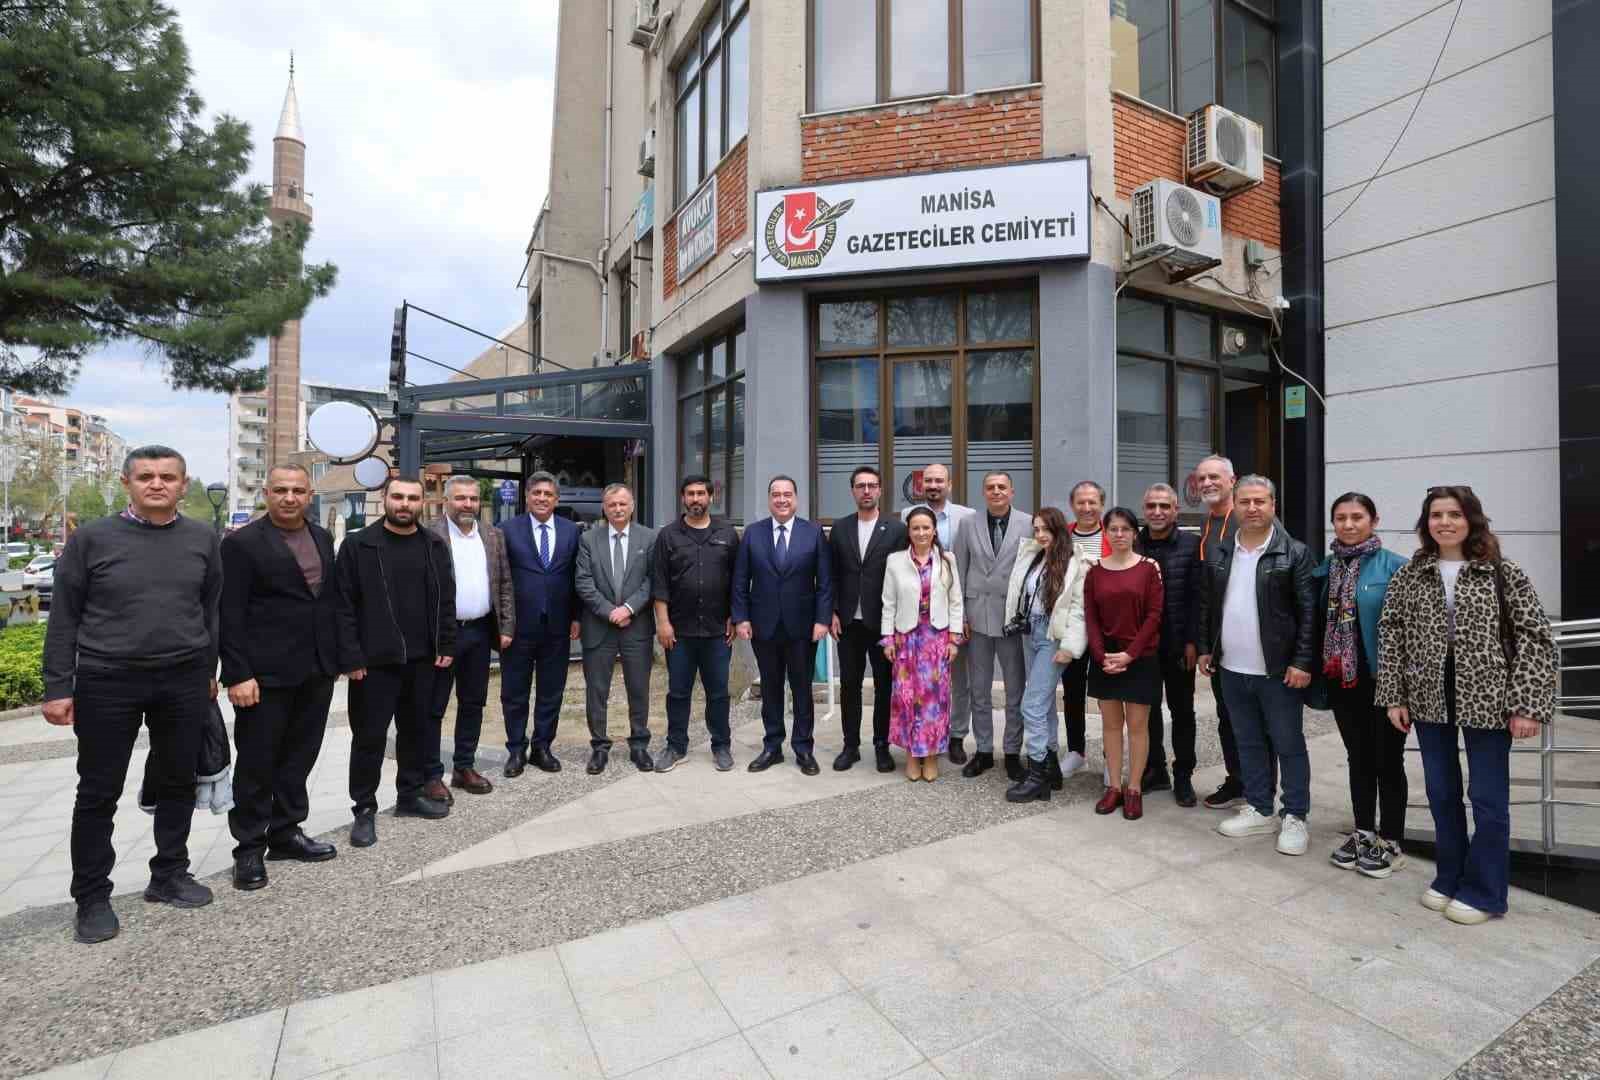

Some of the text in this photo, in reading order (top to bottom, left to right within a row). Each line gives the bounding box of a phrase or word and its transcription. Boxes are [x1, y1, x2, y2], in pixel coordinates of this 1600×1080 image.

[921, 187, 995, 214] MANİSA
[847, 211, 1075, 254] GAZETECİLER CEMİYETİ
[790, 254, 820, 266] MANİSA
